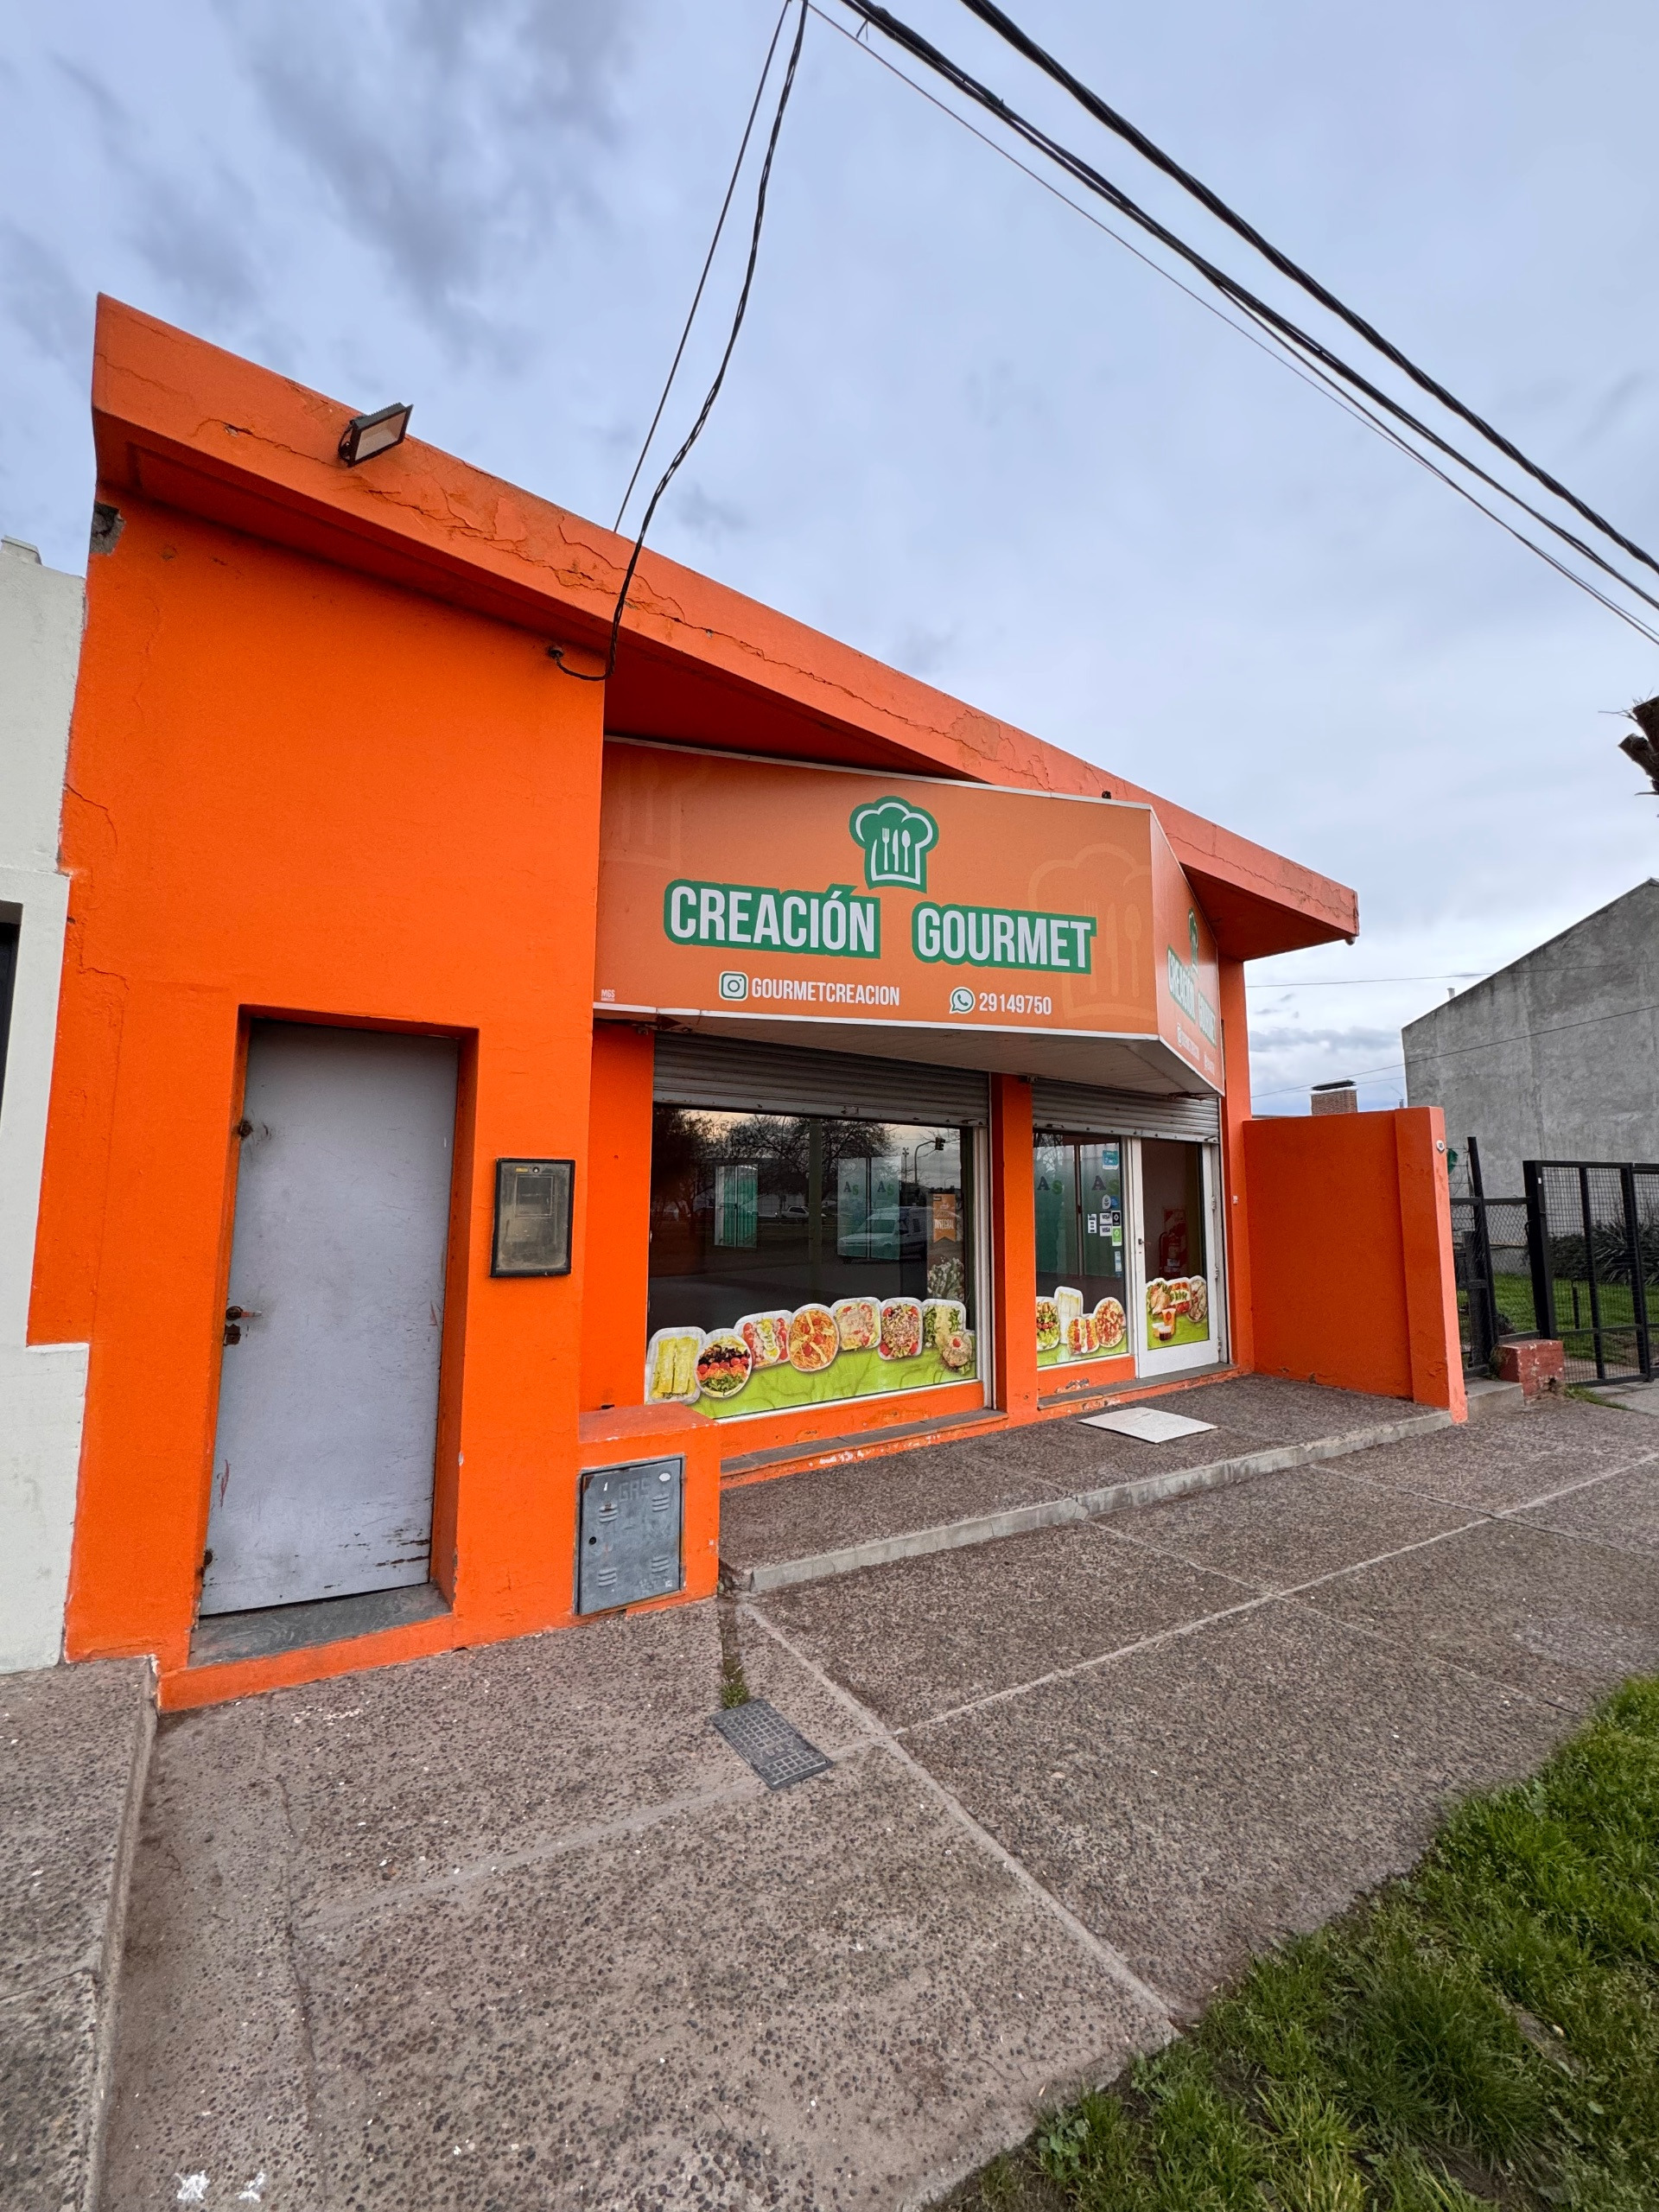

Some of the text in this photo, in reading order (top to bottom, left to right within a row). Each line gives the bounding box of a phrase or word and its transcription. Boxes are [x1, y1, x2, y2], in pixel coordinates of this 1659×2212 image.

[671, 886, 1091, 968] CREACIÓN GOURMET
[752, 977, 899, 1006] GOURMETCREACION
[979, 993, 1052, 1015] 29149750
